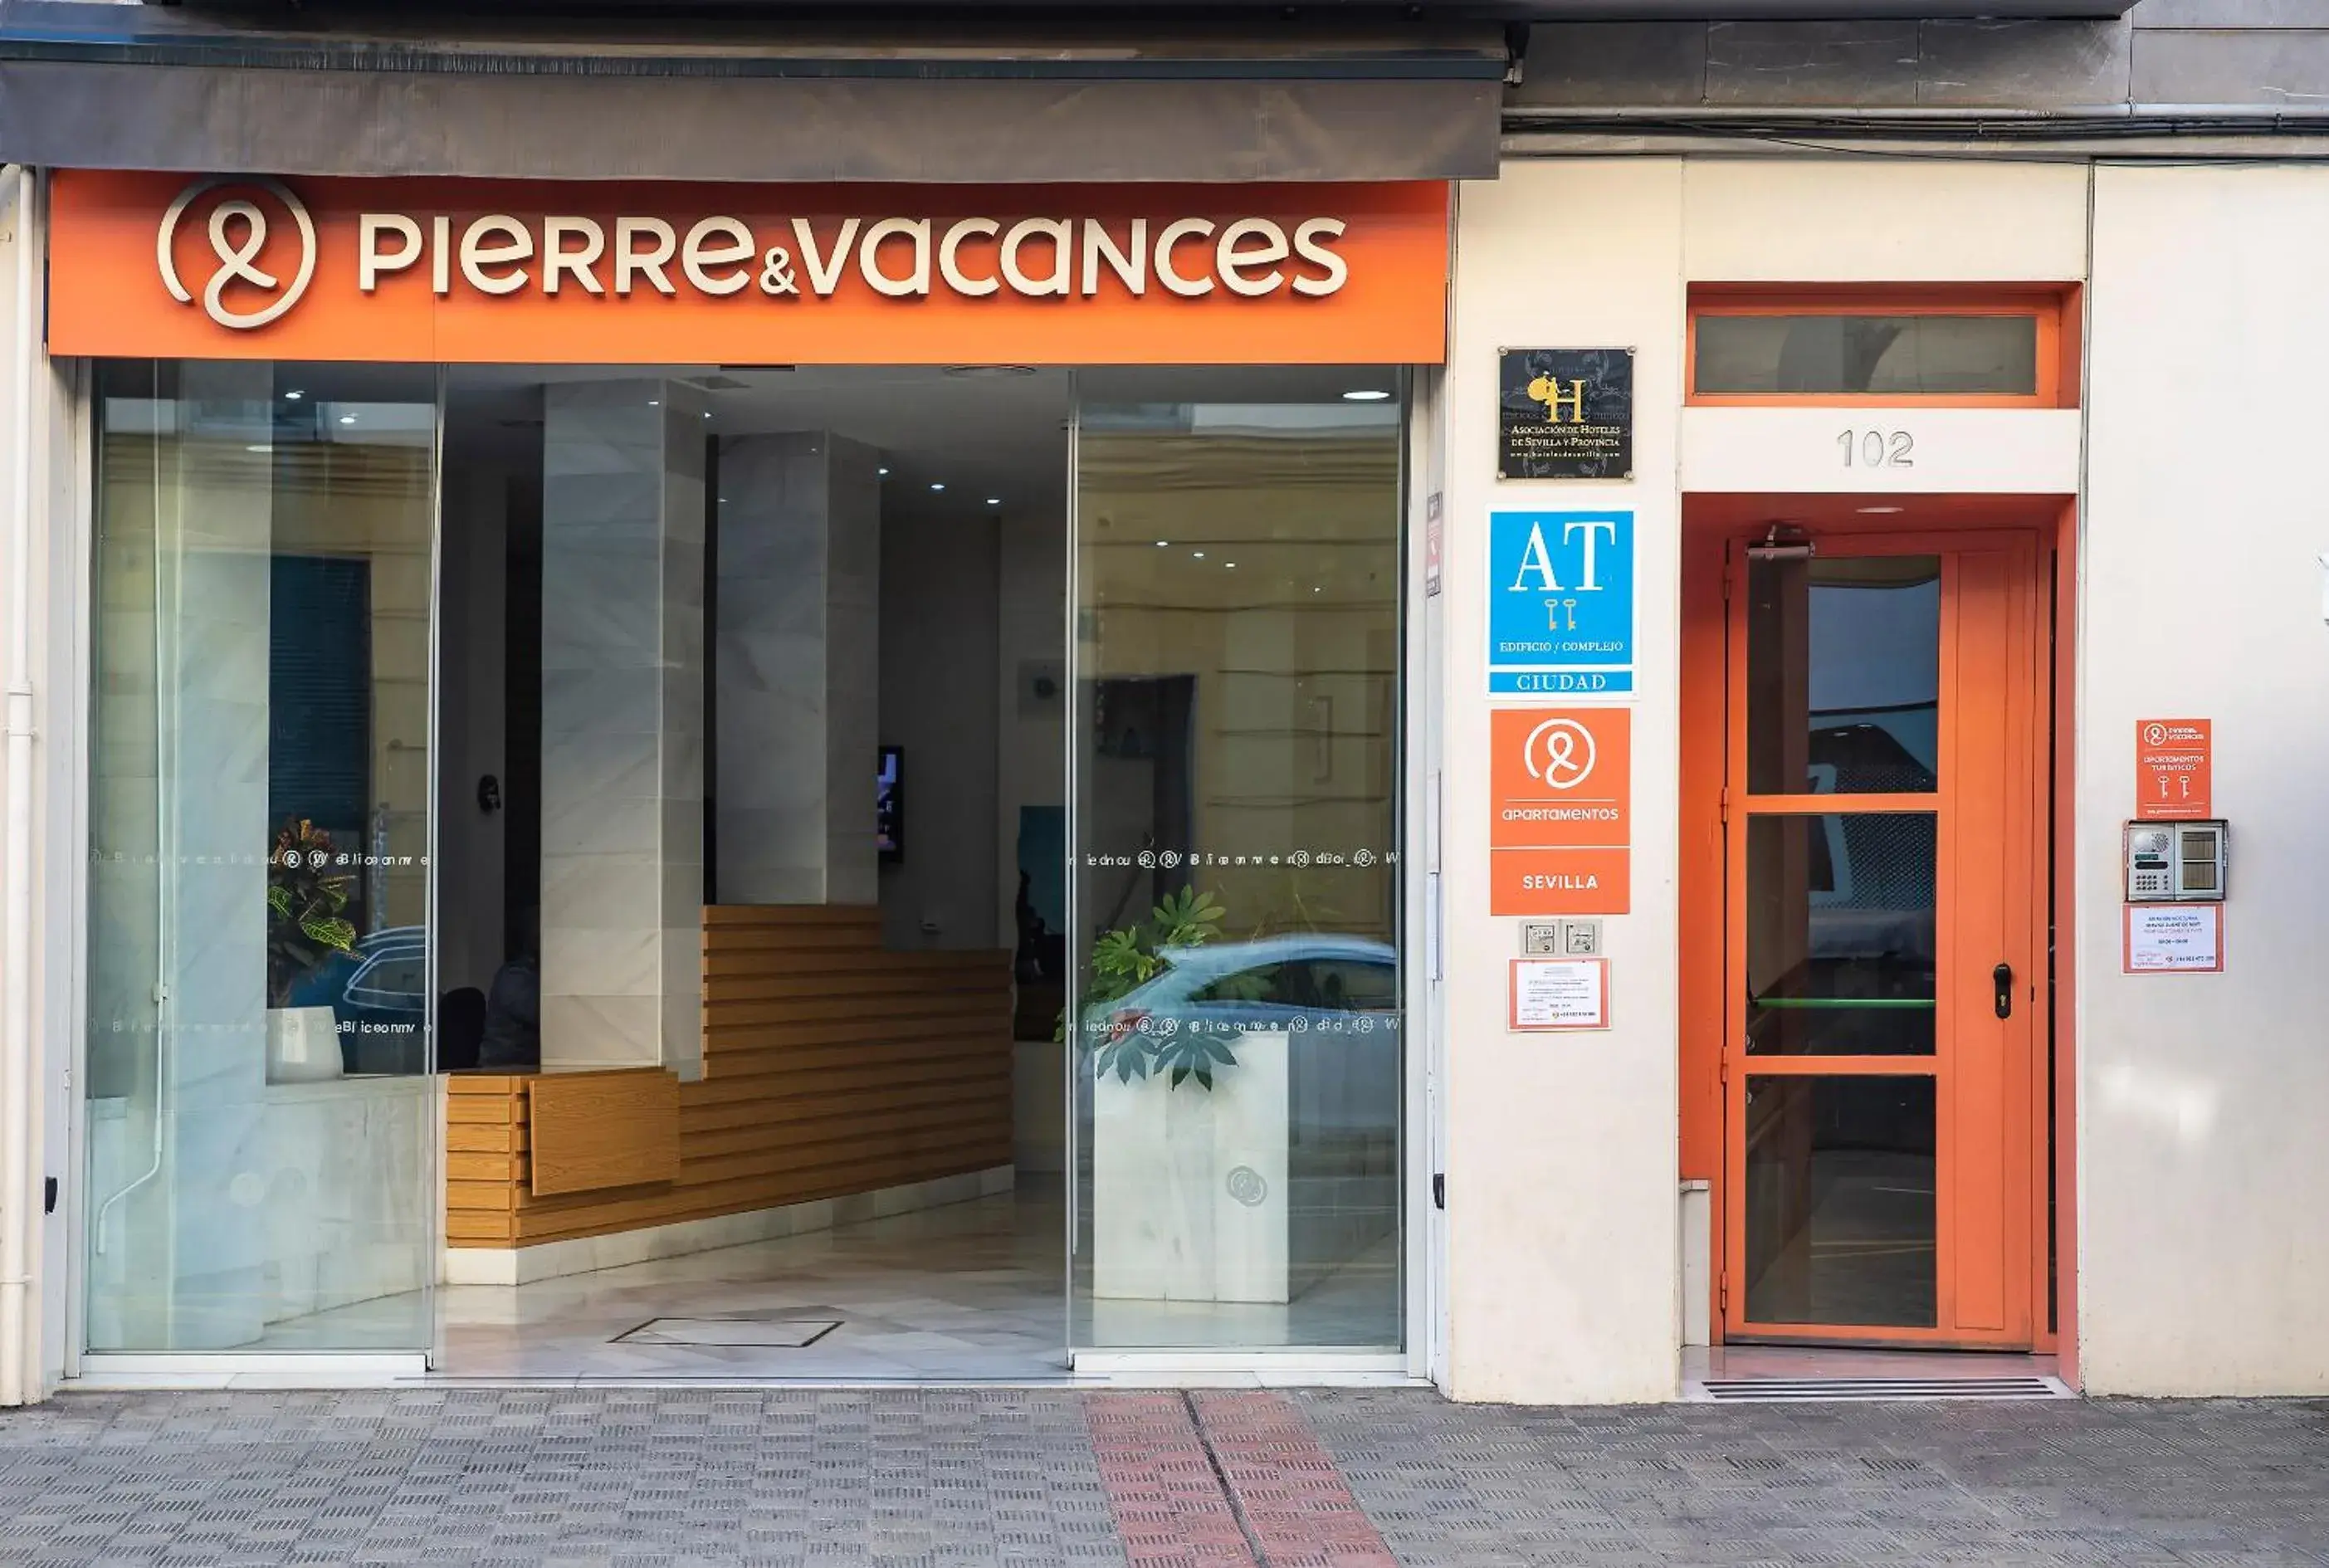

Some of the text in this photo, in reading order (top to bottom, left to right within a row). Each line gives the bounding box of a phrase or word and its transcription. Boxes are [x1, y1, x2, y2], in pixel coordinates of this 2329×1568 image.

[1567, 426, 1579, 434] DE
[1580, 425, 1620, 434] HOTELES
[1525, 437, 1561, 446] SEVILLA
[1570, 437, 1620, 446] PROVINCIA
[1837, 429, 1914, 466] 102
[1508, 521, 1616, 591] AT
[1500, 641, 1623, 654] EDIFICIO / COMPLEJO
[1516, 674, 1607, 691] CIUDAD
[1522, 874, 1599, 890] SEVILLA
